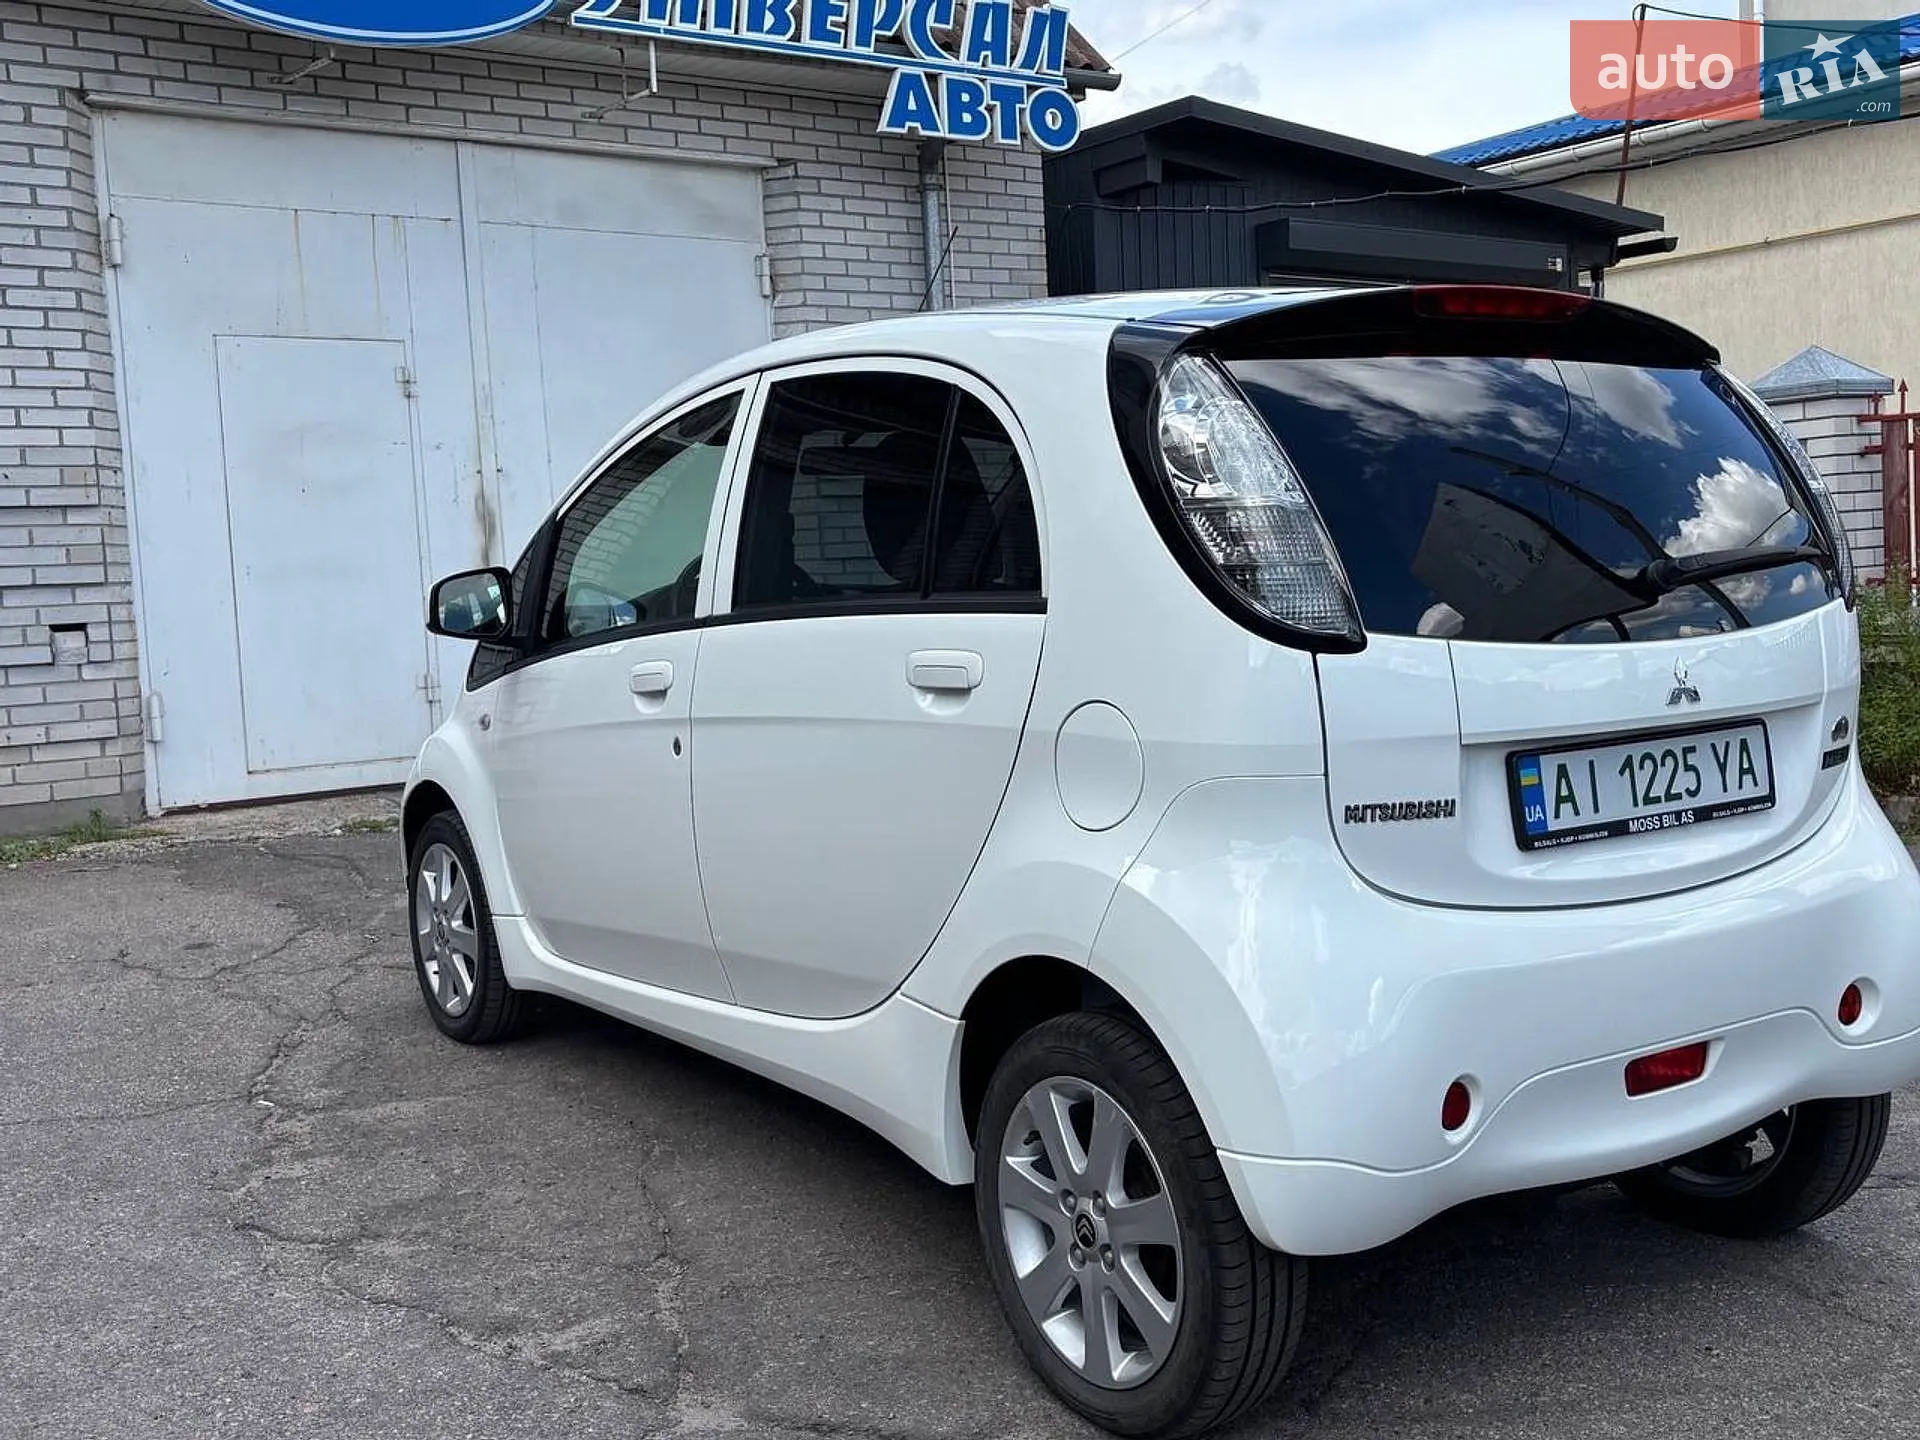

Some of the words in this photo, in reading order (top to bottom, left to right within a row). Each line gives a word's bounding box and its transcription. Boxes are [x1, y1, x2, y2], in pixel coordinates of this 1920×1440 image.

[573, 0, 1069, 75] ВЕРСАЛ
[877, 67, 1080, 151] АВТО
[1618, 745, 1702, 808] 1225
[1710, 738, 1759, 793] YA
[1344, 798, 1457, 824] MITSUBISHI
[1525, 804, 1545, 822] UA
[1629, 817, 1661, 833] MOSS
[1662, 813, 1679, 827] BIL
[1681, 810, 1695, 823] AS
